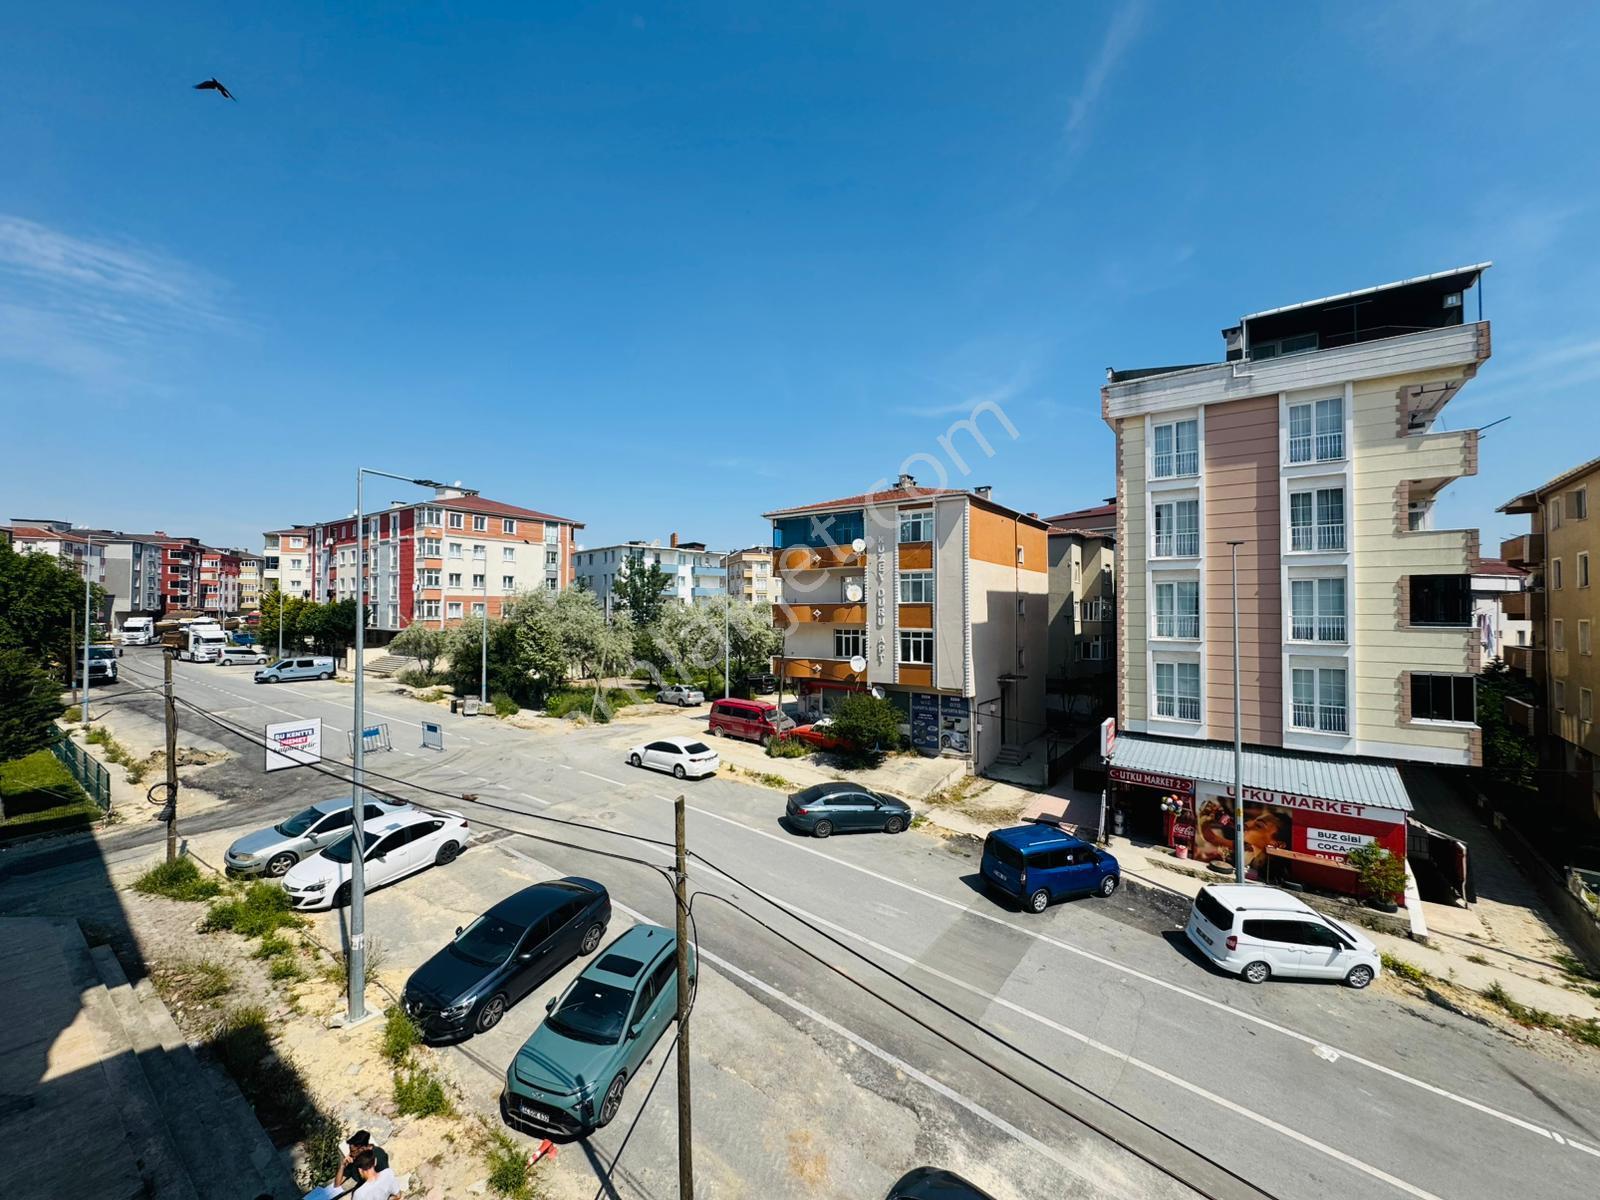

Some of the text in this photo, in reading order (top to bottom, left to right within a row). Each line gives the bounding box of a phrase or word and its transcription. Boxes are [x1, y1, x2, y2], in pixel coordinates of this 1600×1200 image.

[877, 535, 886, 664] KUZEY DURU APT
[286, 731, 313, 739] KENTTE
[1119, 770, 1181, 789] UTKU MARKET 2
[1226, 786, 1366, 817] UTKU MARKET
[1317, 831, 1361, 844] BUZ GİBİ
